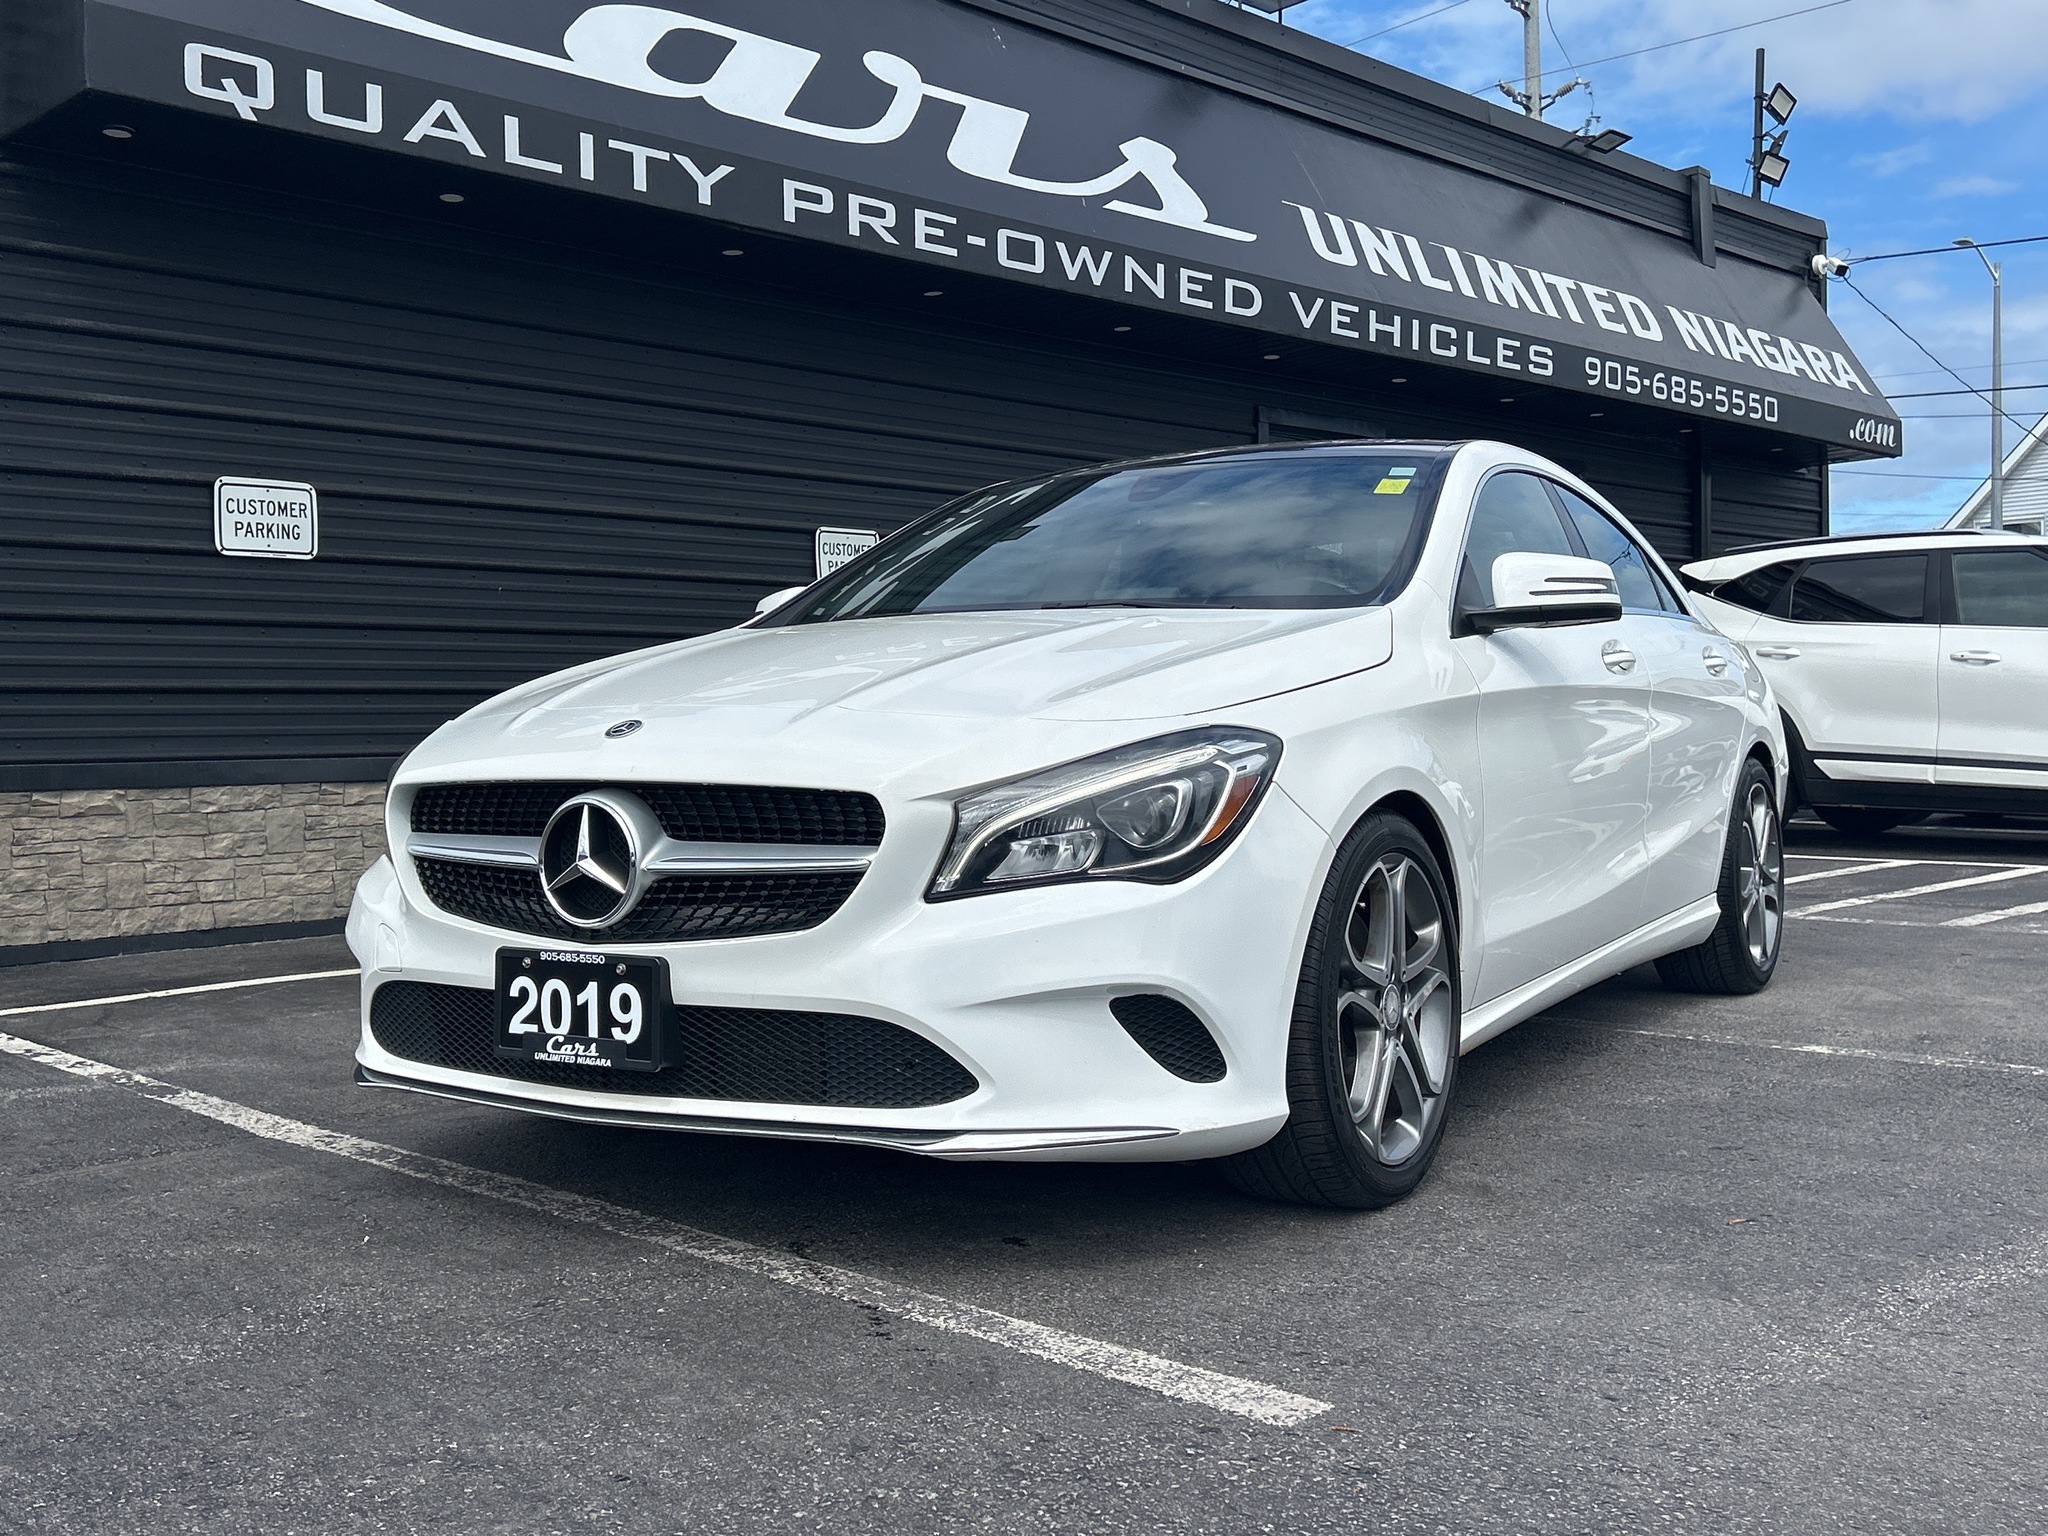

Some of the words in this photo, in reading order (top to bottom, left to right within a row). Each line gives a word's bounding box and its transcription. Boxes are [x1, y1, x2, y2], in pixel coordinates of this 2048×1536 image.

[300, 0, 1257, 242] ars
[183, 42, 736, 206] QUALITY
[782, 177, 1263, 318] PRE-OWNED
[1288, 291, 1554, 378] VEHICLES
[1281, 200, 1664, 342] UNLIMITED
[1664, 304, 1874, 396] NIAGARA
[1584, 356, 1779, 424] 905-685-5550
[1848, 417, 1897, 448] .com
[225, 497, 308, 519] CUSTOMER
[234, 521, 301, 541] PARKING
[539, 951, 606, 965] 905-685-5550
[508, 975, 643, 1045] 2019
[534, 1051, 576, 1065] UNLIMITED
[576, 1056, 612, 1068] NIAGARA
[546, 1035, 600, 1057] Cars
